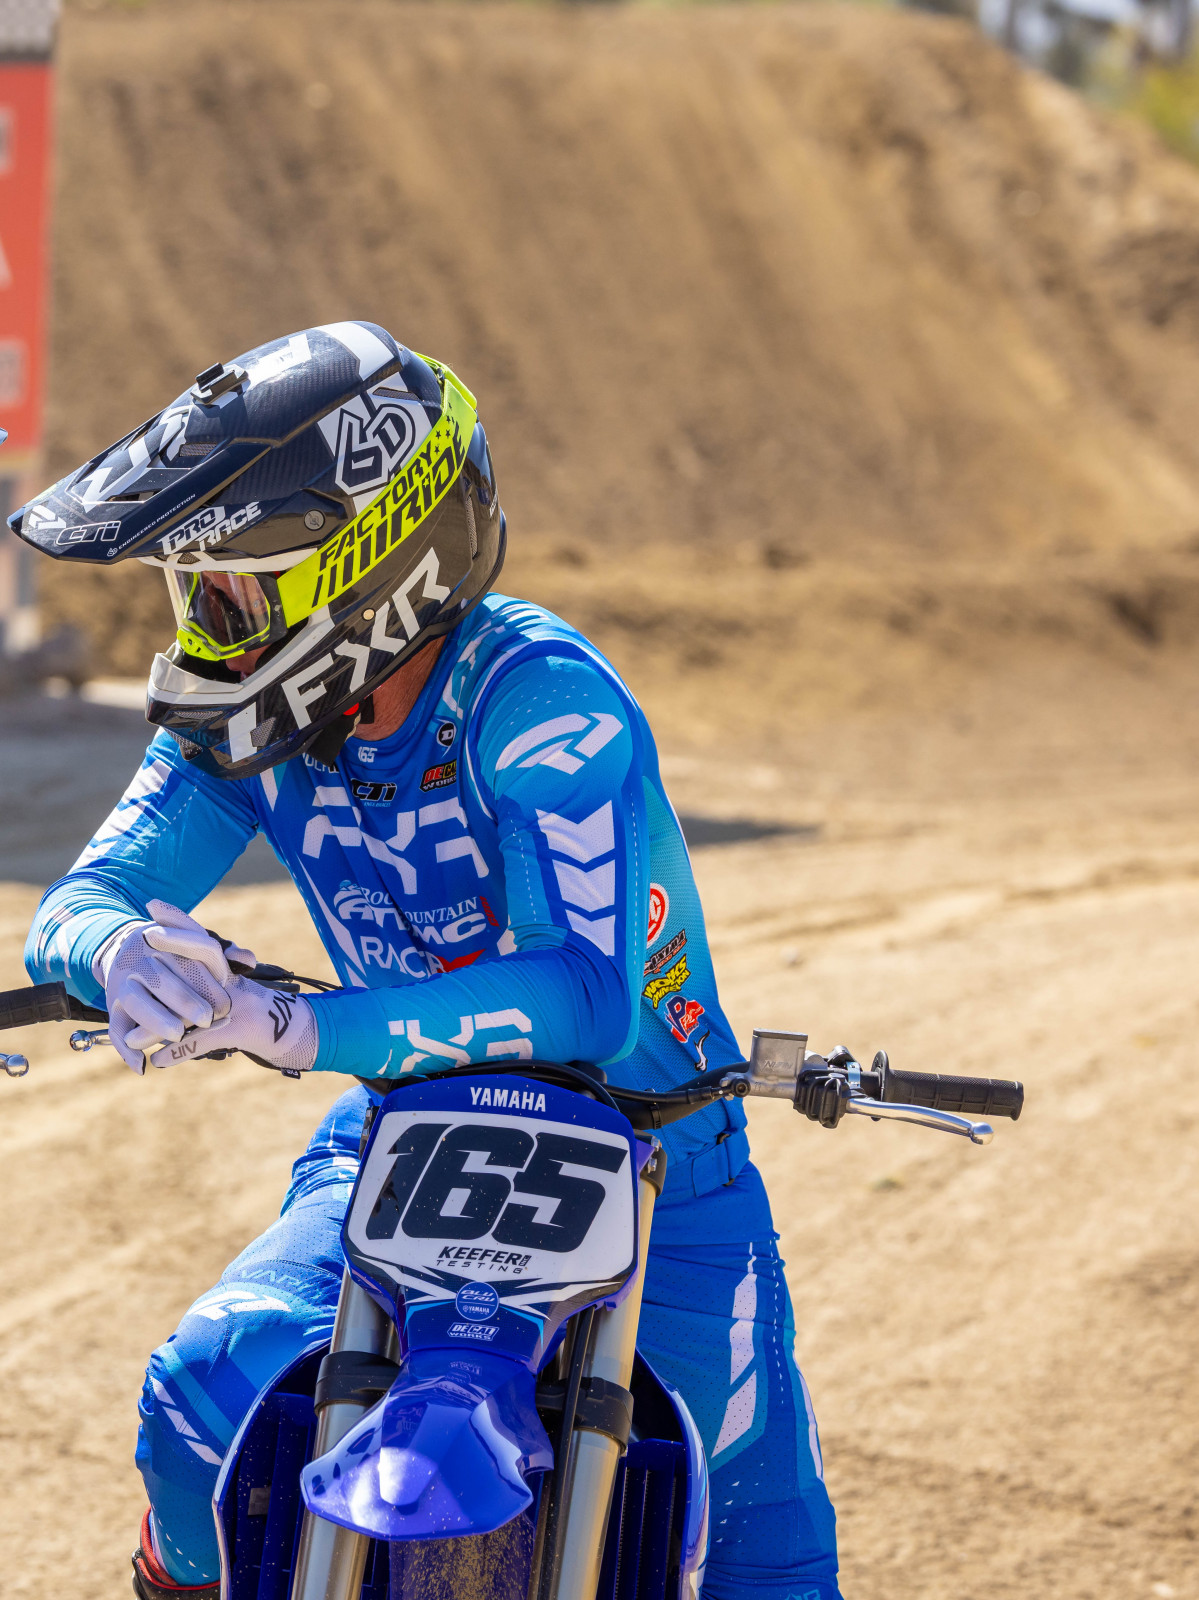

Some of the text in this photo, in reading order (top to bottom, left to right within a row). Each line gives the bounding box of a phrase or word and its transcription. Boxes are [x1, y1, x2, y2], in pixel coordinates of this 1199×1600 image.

[156, 493, 196, 523] PROTECTION
[319, 441, 433, 572] FACTORY
[164, 507, 221, 552] PRO
[197, 501, 262, 551] RACE
[281, 548, 451, 731] FXR
[404, 896, 478, 924] OUNTAIN
[470, 1087, 546, 1112] YAMAHA
[365, 1123, 628, 1253] 165
[436, 1259, 523, 1275] TESTING
[438, 1246, 522, 1266] KEEFER
[469, 1306, 490, 1314] YAMAHA
[449, 1332, 492, 1340] WORKS
[452, 1324, 495, 1336] DECAL
